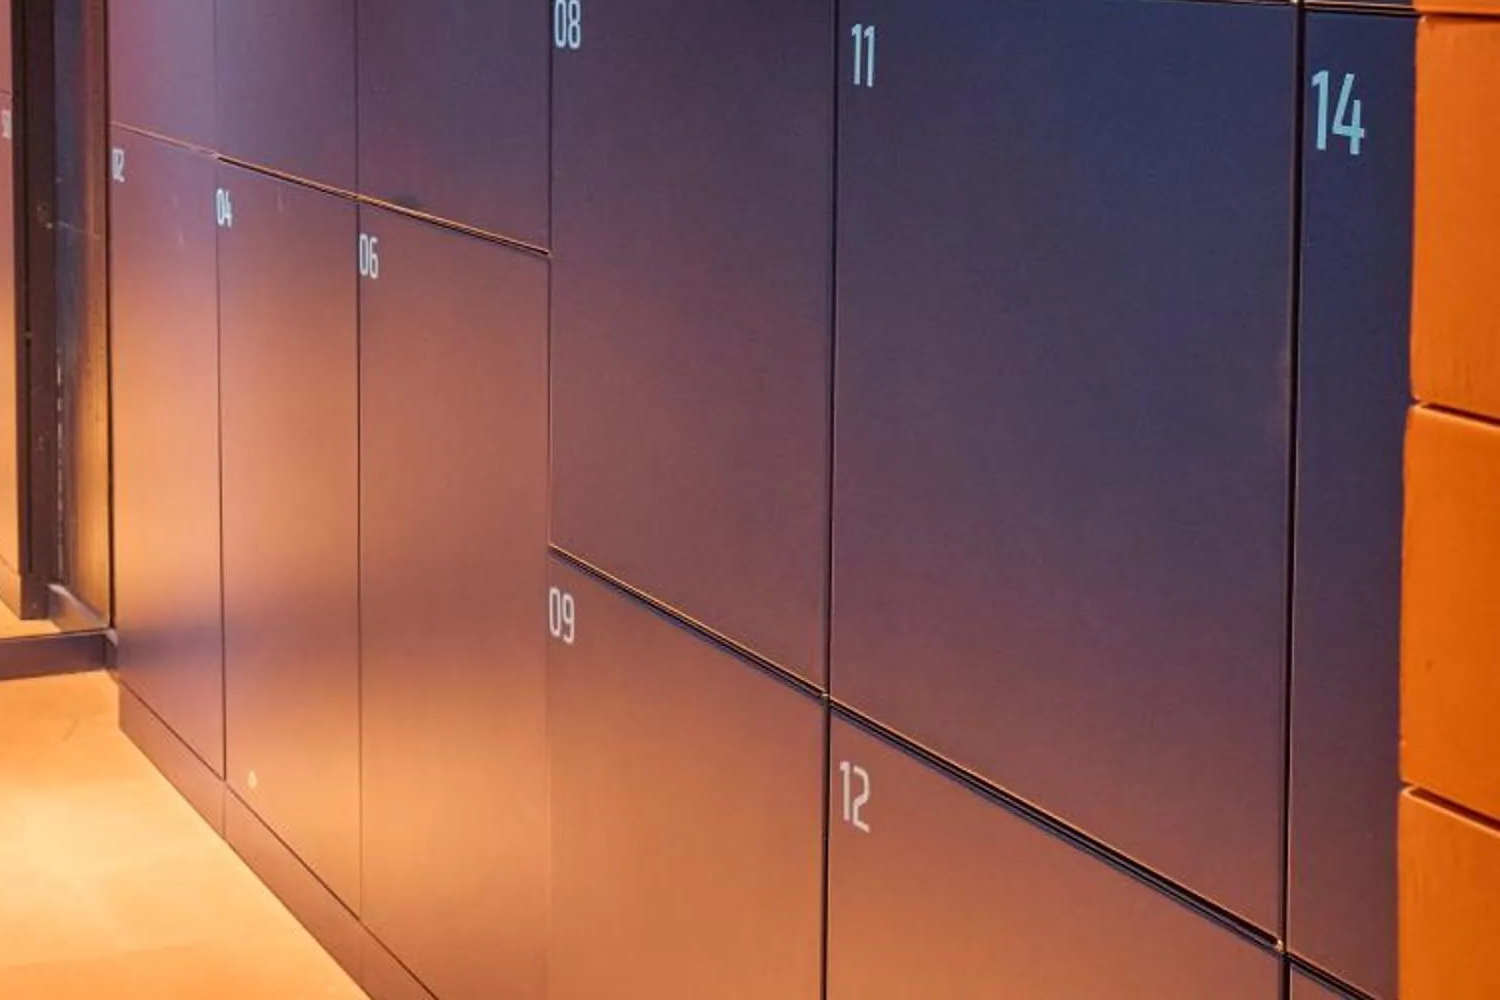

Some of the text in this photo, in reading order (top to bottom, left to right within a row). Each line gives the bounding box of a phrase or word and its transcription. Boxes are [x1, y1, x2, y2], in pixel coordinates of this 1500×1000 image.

[850, 23, 876, 88] 11
[1312, 70, 1366, 155] 14
[216, 188, 232, 227] 04
[358, 233, 379, 279] 06
[548, 586, 575, 644] 09
[839, 761, 870, 833] 12
